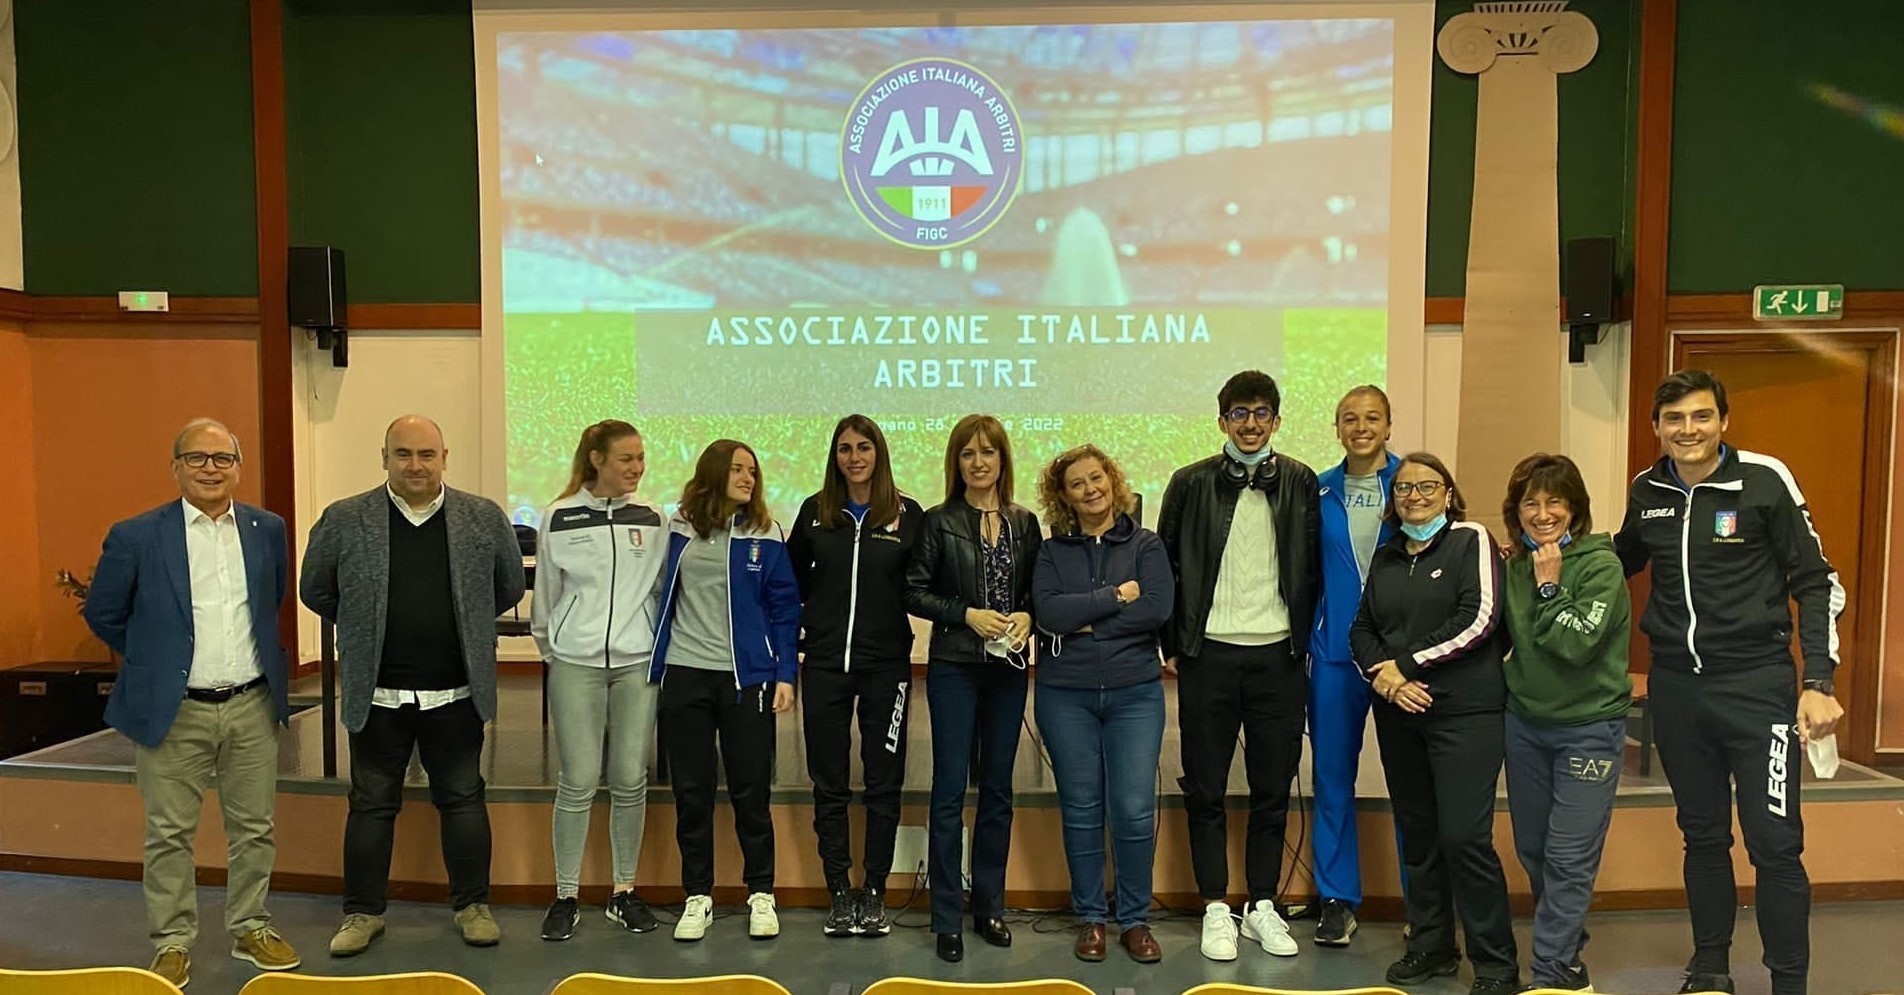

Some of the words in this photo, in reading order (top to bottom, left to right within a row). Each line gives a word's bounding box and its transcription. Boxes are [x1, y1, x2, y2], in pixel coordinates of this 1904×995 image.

[850, 70, 918, 154] ASSOCIAZIONE
[922, 67, 985, 99] ITALIANA
[984, 97, 1016, 152] ARBITRI
[870, 106, 994, 176] AIA
[918, 197, 946, 210] 1911
[916, 227, 948, 240] FIGC
[706, 316, 989, 346] ASSOCIAZIONE
[1017, 314, 1210, 344] ITALIANA
[874, 359, 1037, 388] ARBITRI
[1023, 417, 1063, 431] 2022
[1641, 507, 1675, 519] LEGEA
[885, 682, 908, 753] LEGEA
[1569, 757, 1613, 777] EA7
[1768, 724, 1788, 817] LEGEA
